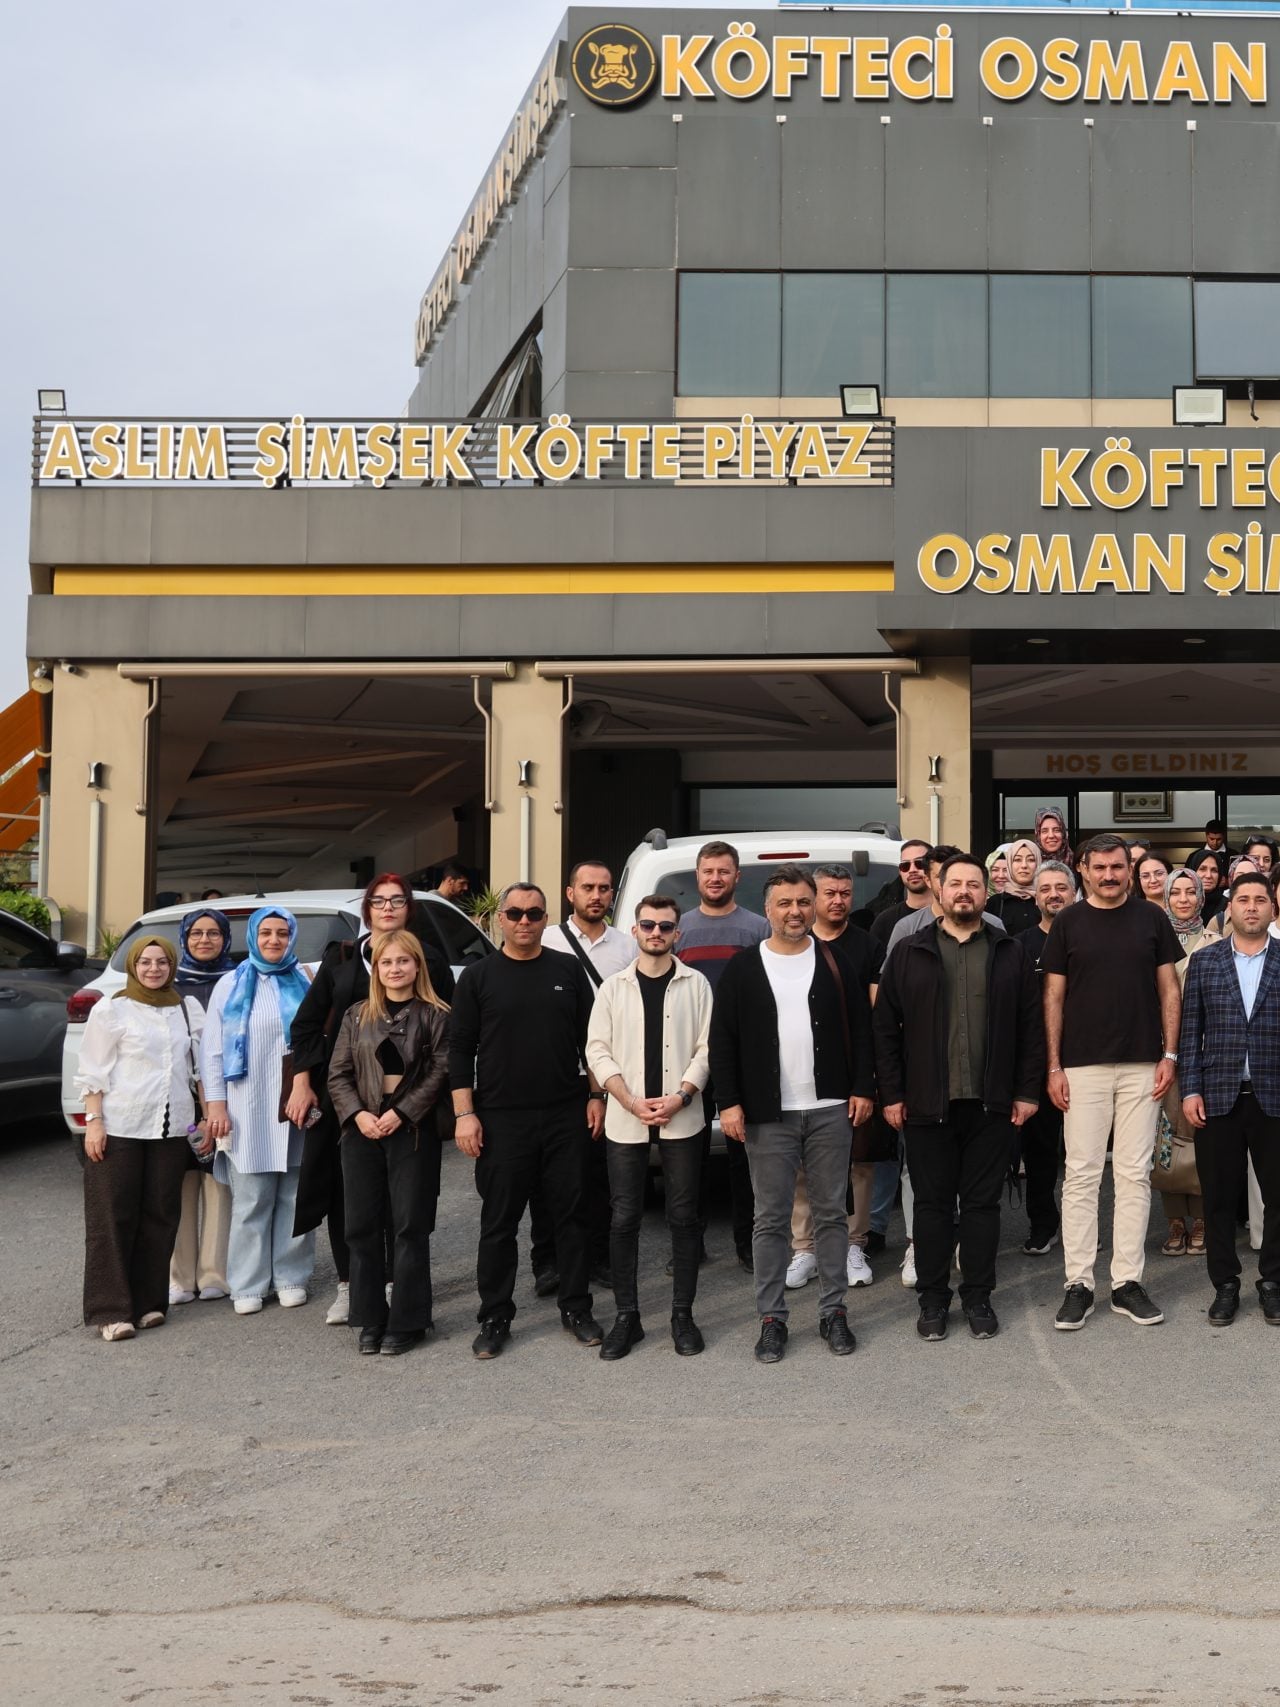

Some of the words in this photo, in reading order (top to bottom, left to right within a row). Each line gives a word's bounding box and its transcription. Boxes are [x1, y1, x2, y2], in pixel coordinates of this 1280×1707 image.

[661, 21, 954, 100] KÖFTECİ
[979, 36, 1267, 102] OSMAN
[40, 423, 229, 480] ASLIM
[252, 414, 474, 489] ŞİMŞEK
[496, 414, 681, 481] KÖFTE
[703, 414, 874, 479] PİYAZ
[917, 532, 1186, 595] OSMAN
[1046, 753, 1102, 775] HOŞ
[1111, 752, 1249, 773] GELDİNİZ
